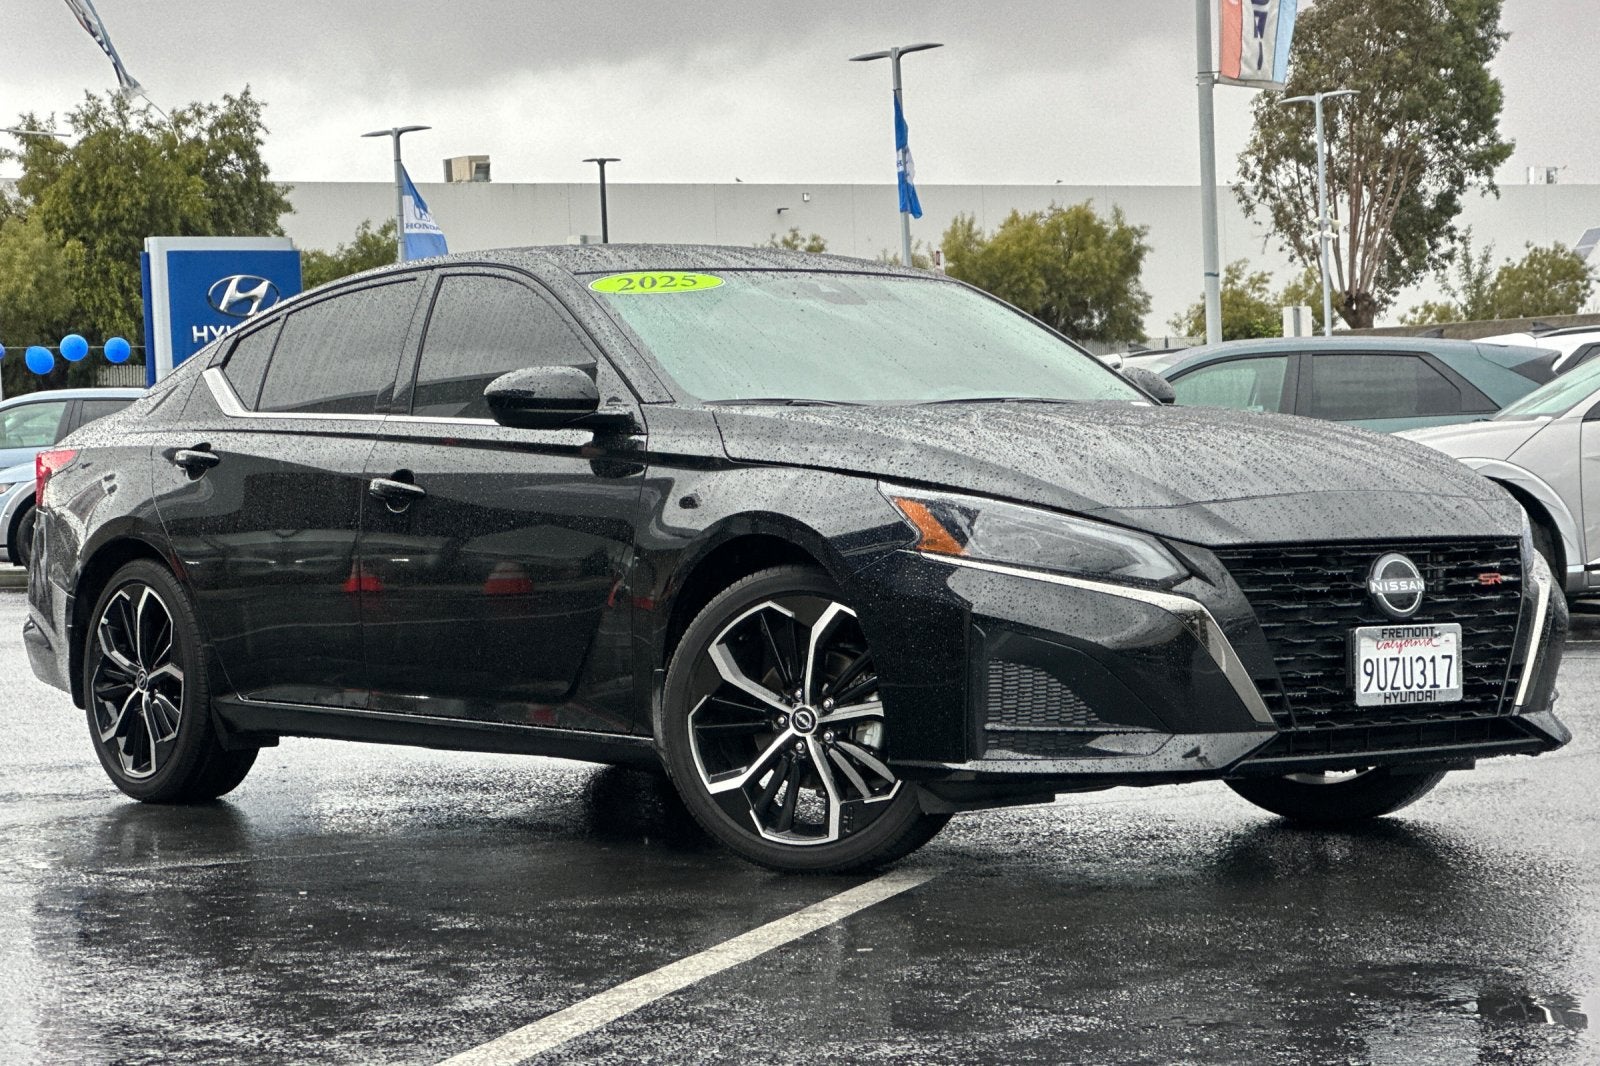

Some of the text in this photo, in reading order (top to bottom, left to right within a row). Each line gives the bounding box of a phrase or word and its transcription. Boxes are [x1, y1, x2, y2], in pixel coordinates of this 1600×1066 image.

[616, 274, 698, 292] 2025
[1478, 572, 1503, 585] SR
[1371, 580, 1425, 592] NISSAN
[1381, 626, 1435, 639] FREMONT
[1375, 637, 1440, 654] California
[1363, 654, 1453, 693] 9UZU317
[1384, 689, 1436, 703] HYUNDAI
